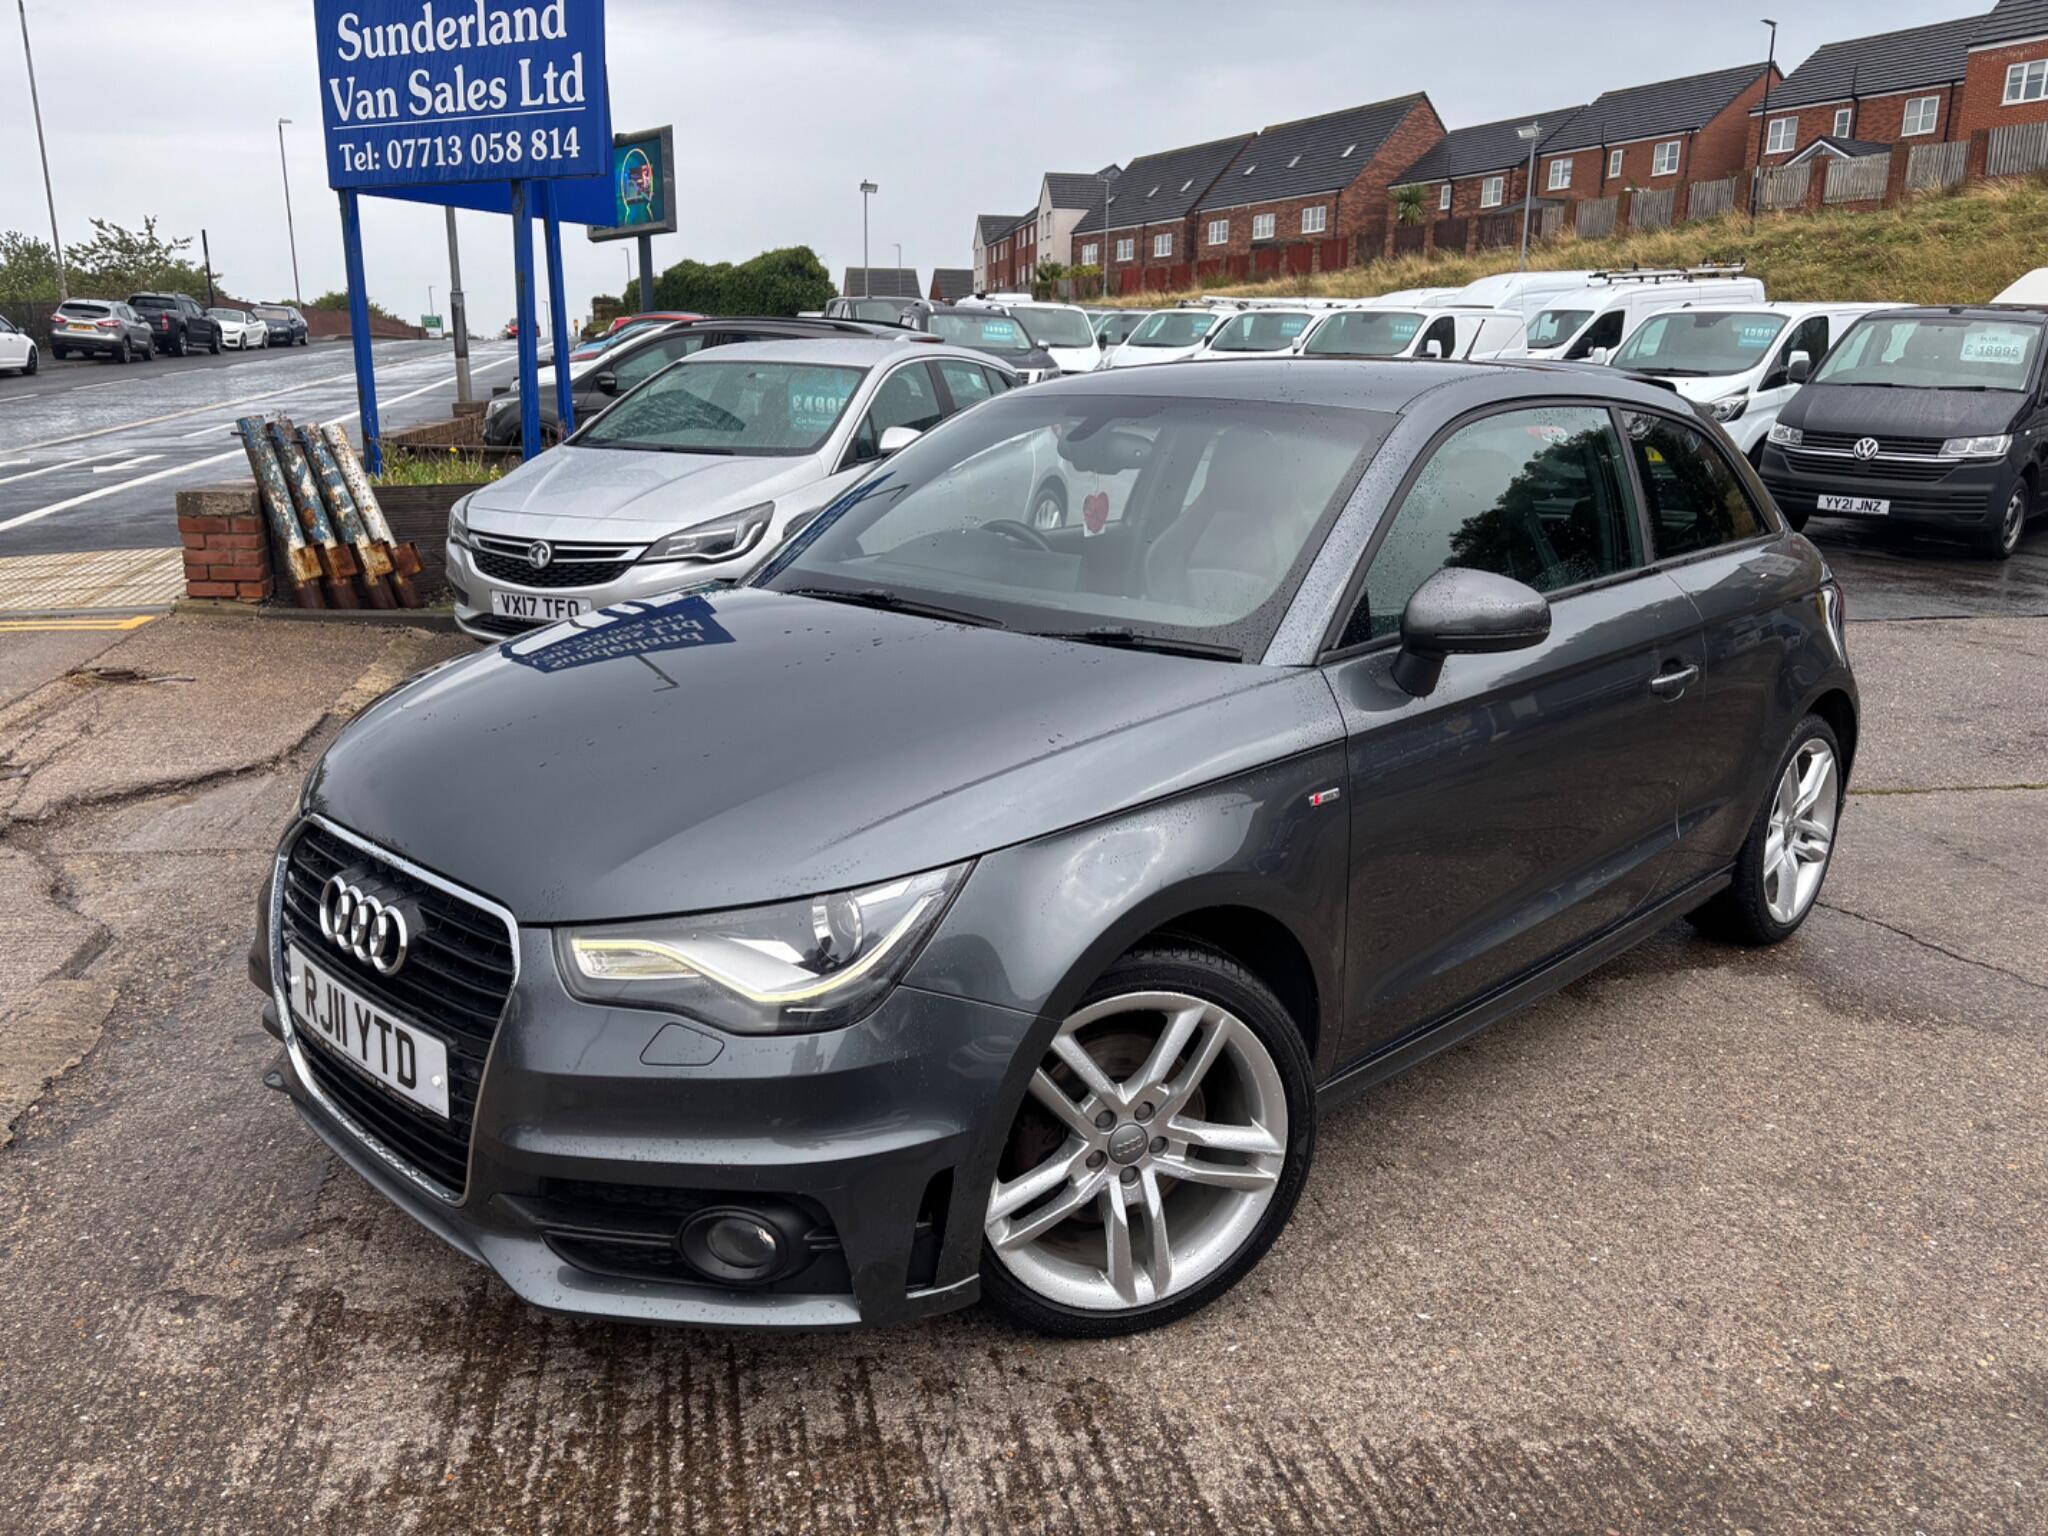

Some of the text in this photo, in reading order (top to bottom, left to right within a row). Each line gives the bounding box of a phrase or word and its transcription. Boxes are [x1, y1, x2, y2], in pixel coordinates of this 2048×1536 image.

[337, 0, 568, 61] Sunderland
[329, 52, 585, 122] Van Sales Ltd
[339, 126, 580, 171] Tel: 07713 058 814
[1826, 496, 1882, 513] YY21 JNZ
[501, 594, 537, 616] VX17
[304, 963, 417, 1090] RJ11 YTD
